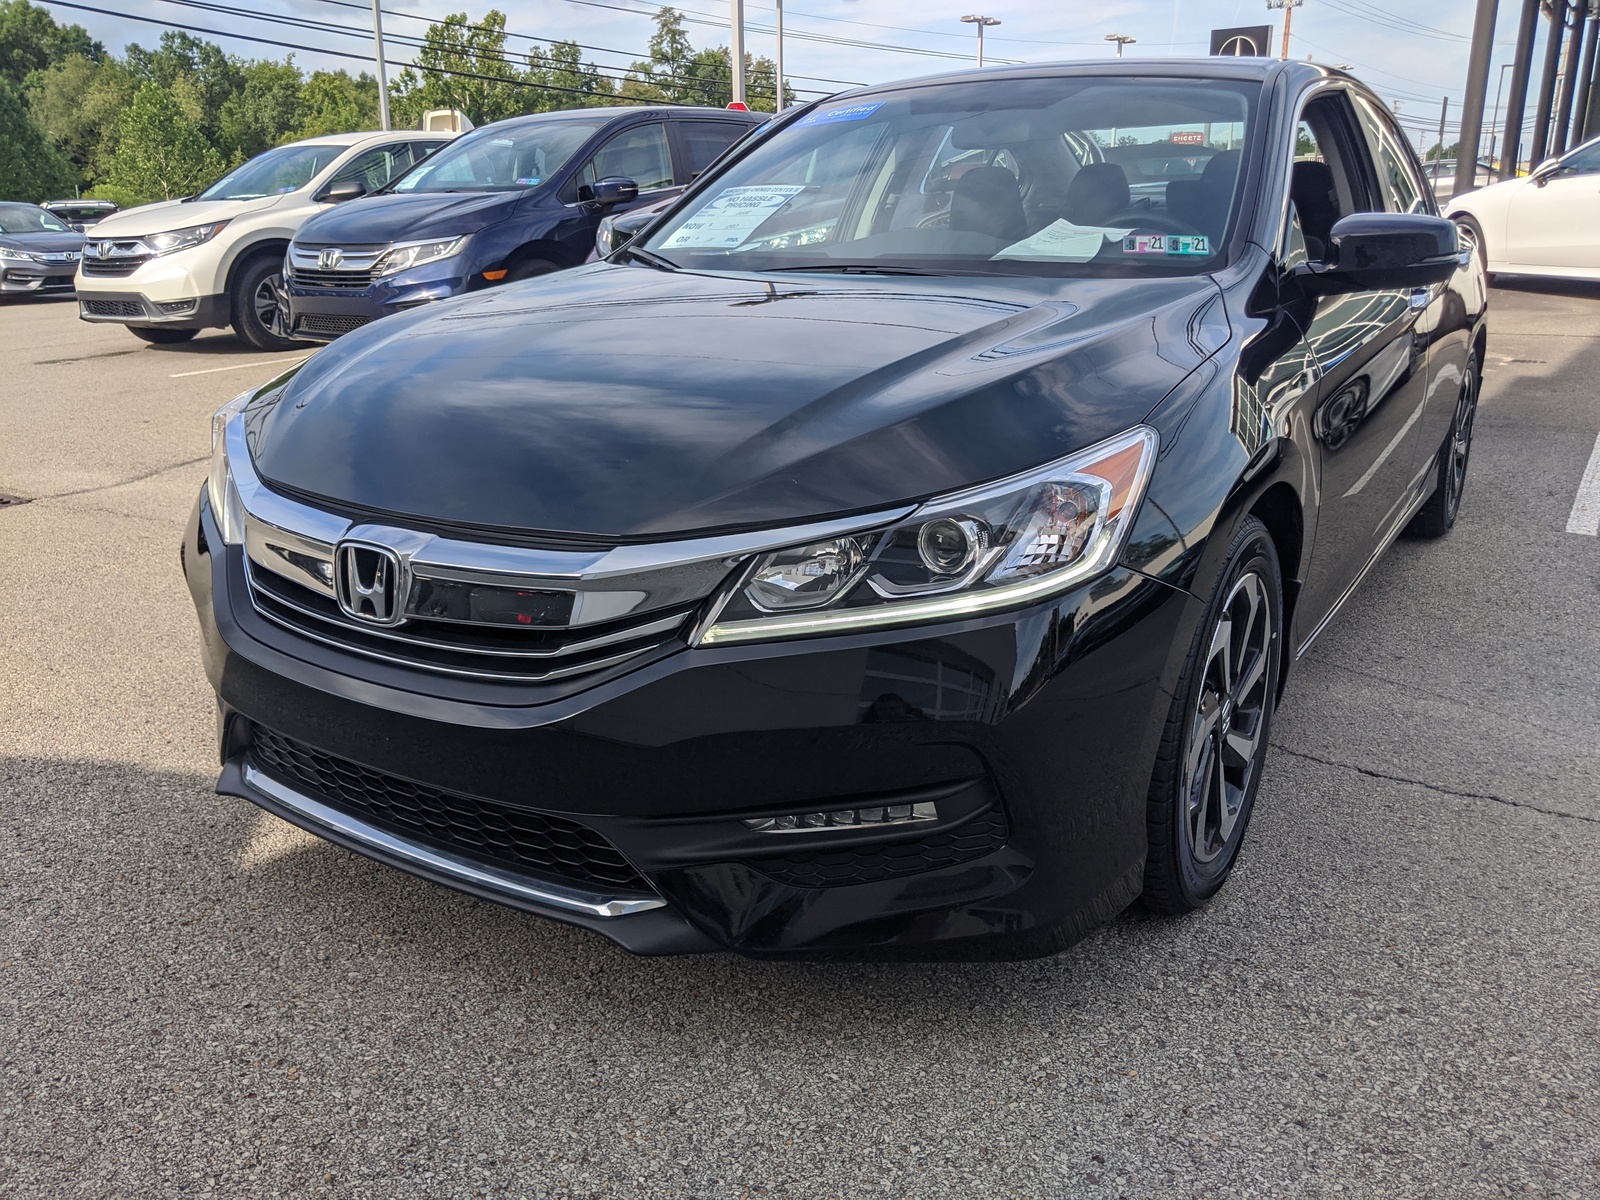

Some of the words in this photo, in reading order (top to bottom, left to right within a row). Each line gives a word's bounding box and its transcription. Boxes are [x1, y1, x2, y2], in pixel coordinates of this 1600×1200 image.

[827, 104, 877, 117] Certified
[682, 222, 705, 230] NOW
[1151, 236, 1163, 250] 21
[1194, 237, 1207, 251] 21
